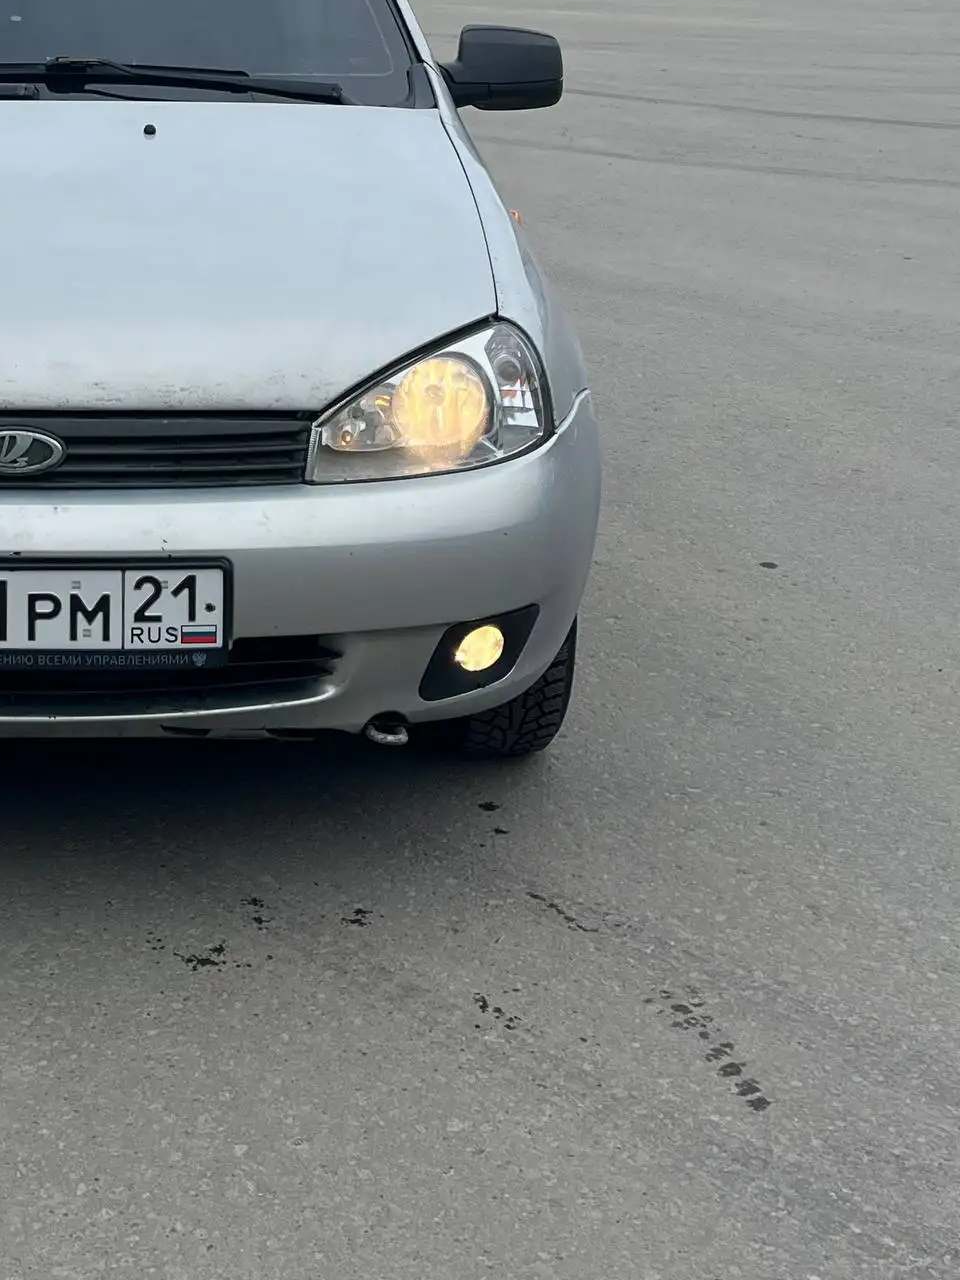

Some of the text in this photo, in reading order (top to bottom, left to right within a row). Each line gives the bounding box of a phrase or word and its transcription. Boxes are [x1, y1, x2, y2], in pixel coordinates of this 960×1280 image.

[133, 574, 197, 623] 21
[130, 626, 178, 643] RUS
[38, 654, 81, 666] ВСЕМИ
[85, 654, 188, 666] УПРАВЛЕНИЯМИ
